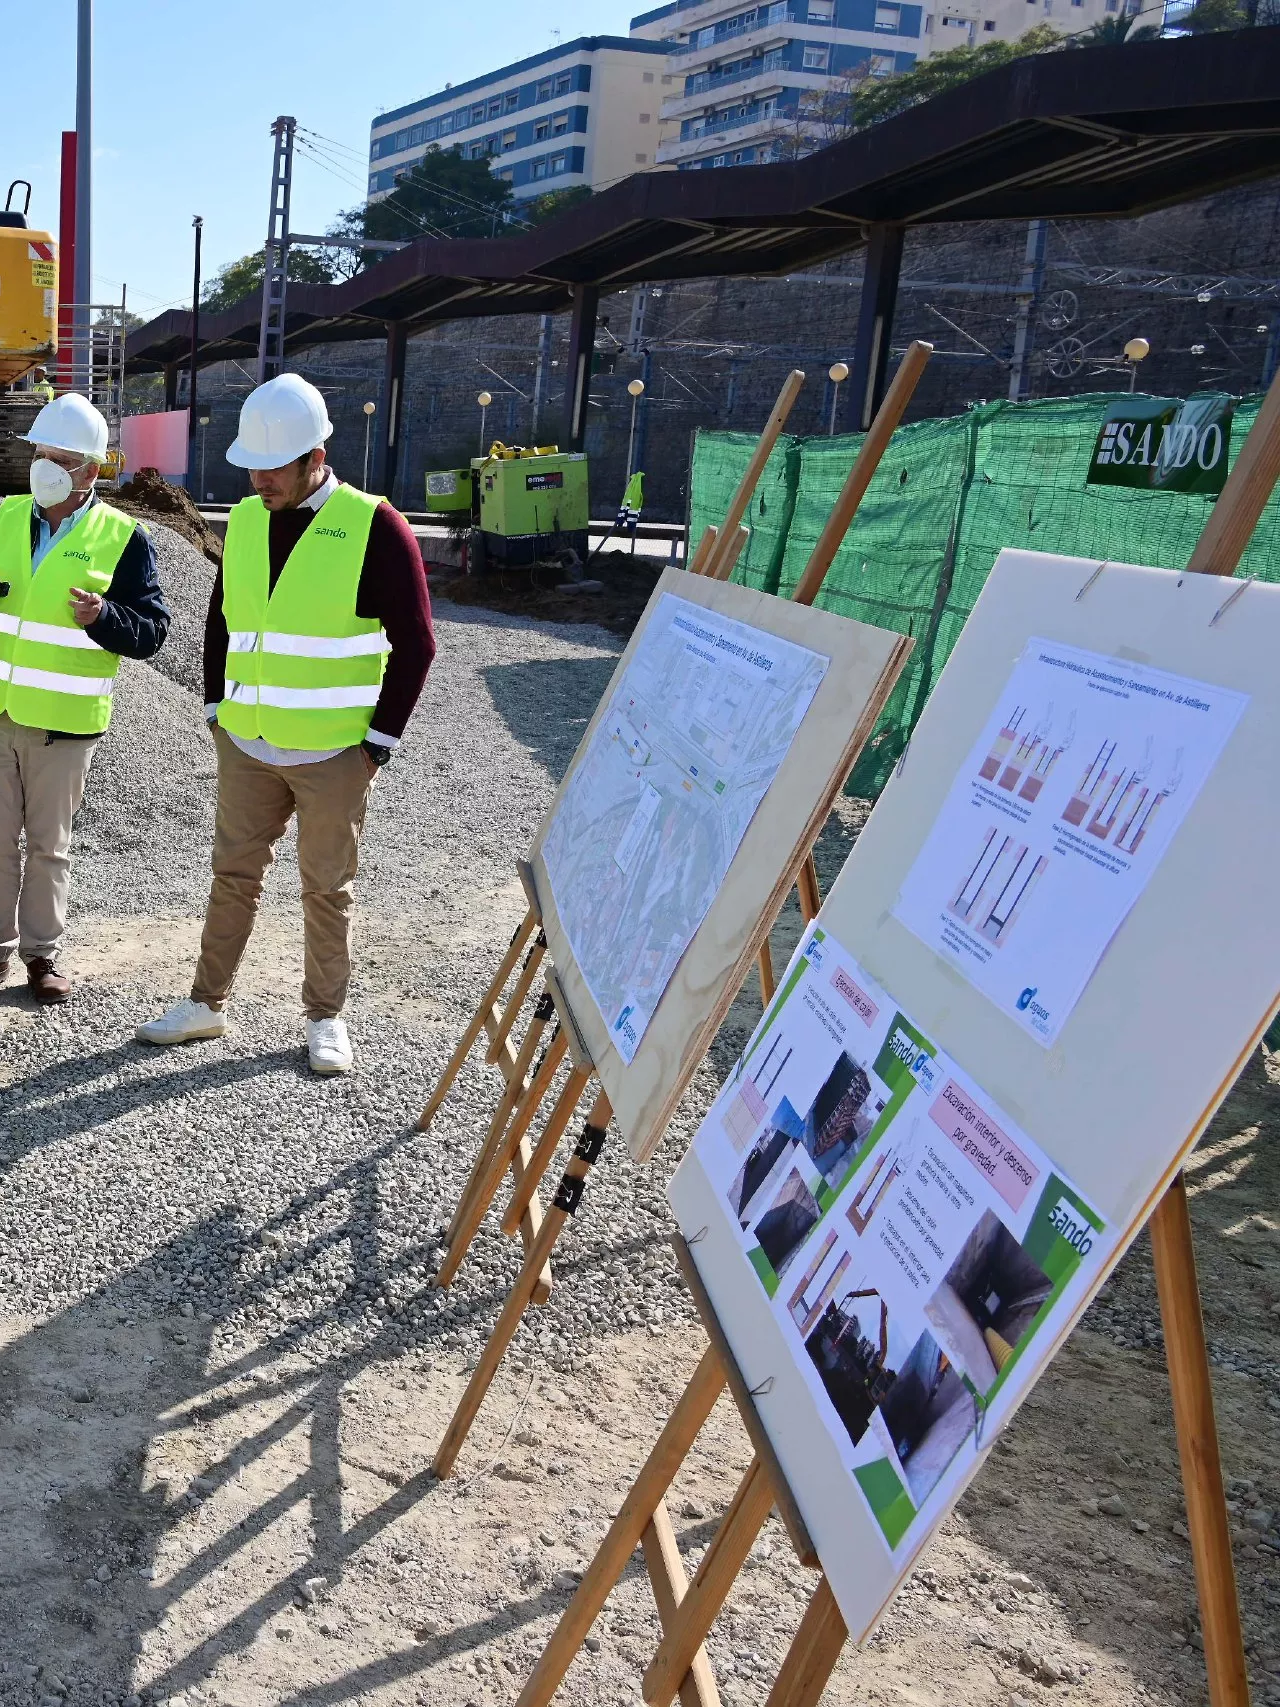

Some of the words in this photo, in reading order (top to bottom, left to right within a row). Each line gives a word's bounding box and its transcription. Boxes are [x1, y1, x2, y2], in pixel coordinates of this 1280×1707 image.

[1111, 423, 1222, 471] SANDO
[314, 527, 347, 539] sando
[63, 550, 91, 562] sando
[1127, 679, 1159, 697] Saneamiento
[1158, 690, 1167, 698] en
[1164, 690, 1175, 701] Av.
[1175, 695, 1183, 703] de
[1181, 696, 1211, 712] Astilleros
[1030, 1001, 1050, 1020] aguas
[888, 1034, 915, 1067] sando
[942, 1085, 976, 1125] Excavación
[973, 1117, 1001, 1149] interior
[995, 1144, 1006, 1157] y
[1003, 1150, 1033, 1186] descenso
[952, 1127, 968, 1143] por
[1047, 1206, 1093, 1257] sando
